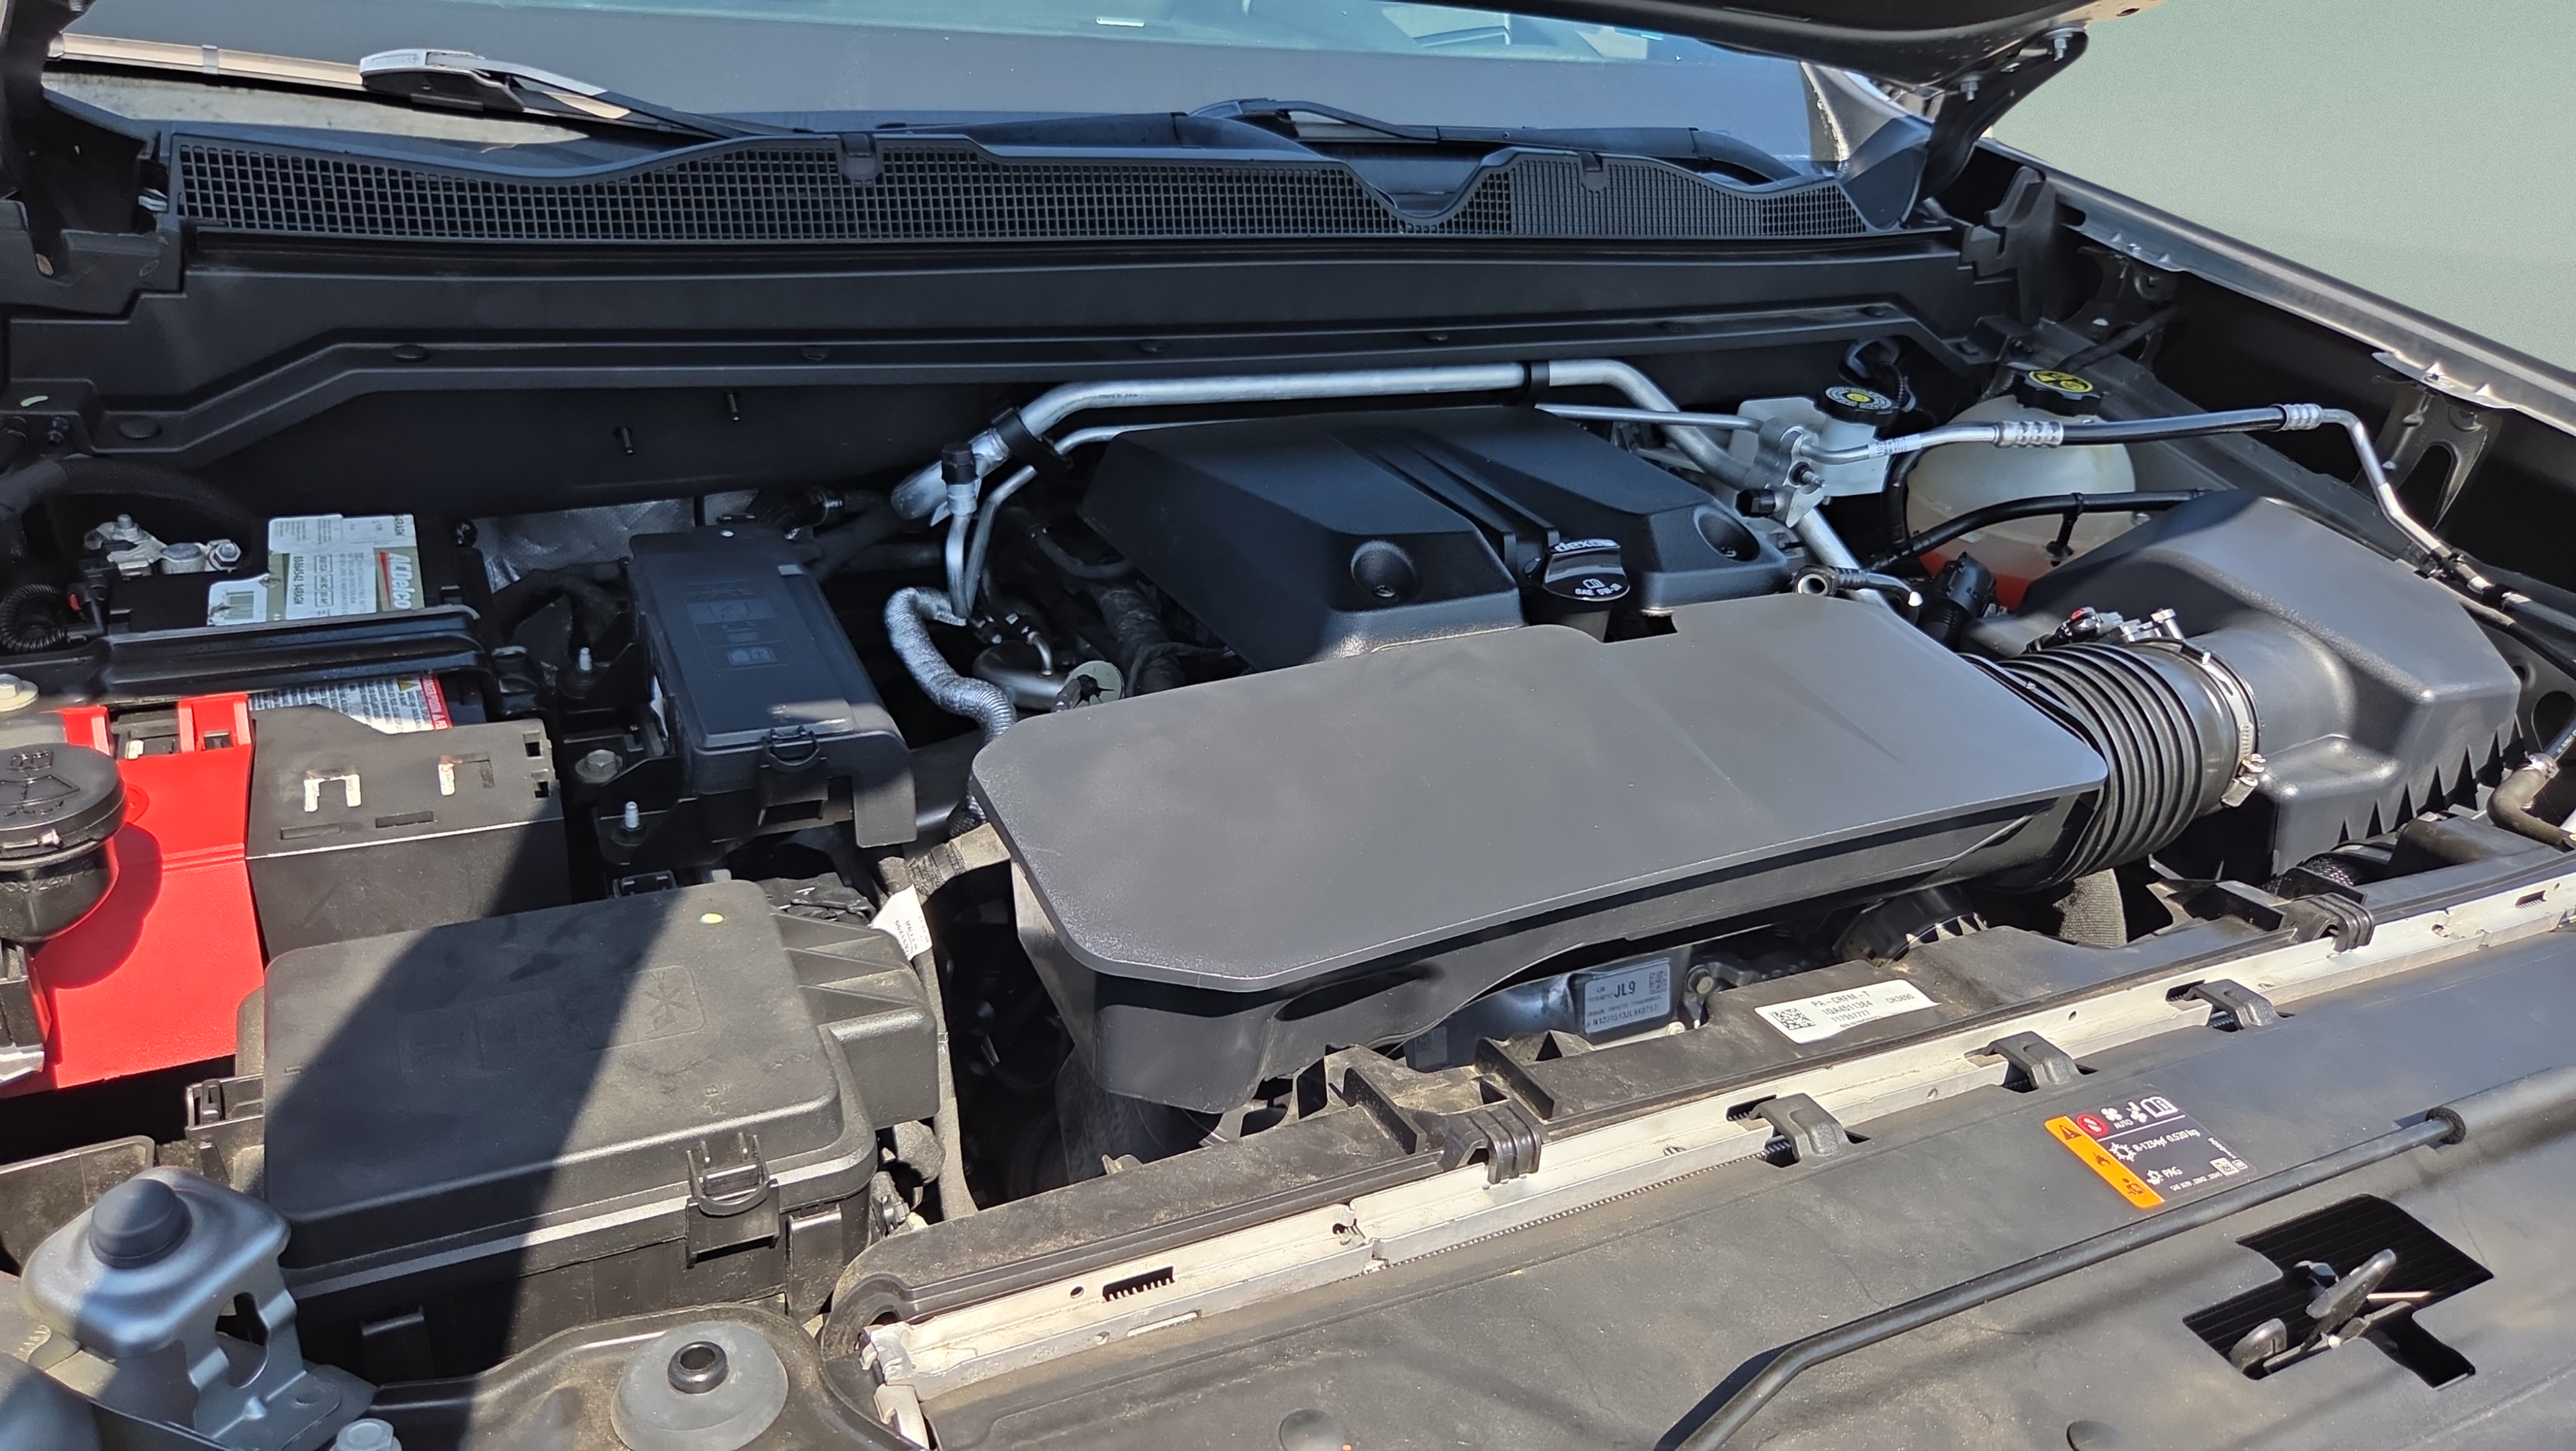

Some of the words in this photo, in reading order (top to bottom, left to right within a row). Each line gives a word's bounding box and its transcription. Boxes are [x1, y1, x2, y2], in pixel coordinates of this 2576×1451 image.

[389, 554, 416, 609] ACDelco
[1614, 981, 1636, 998] JL9
[2114, 1119, 2133, 1130] AUTO
[2131, 1136, 2167, 1153] R-1234yf
[2160, 1166, 2184, 1179] PAG
